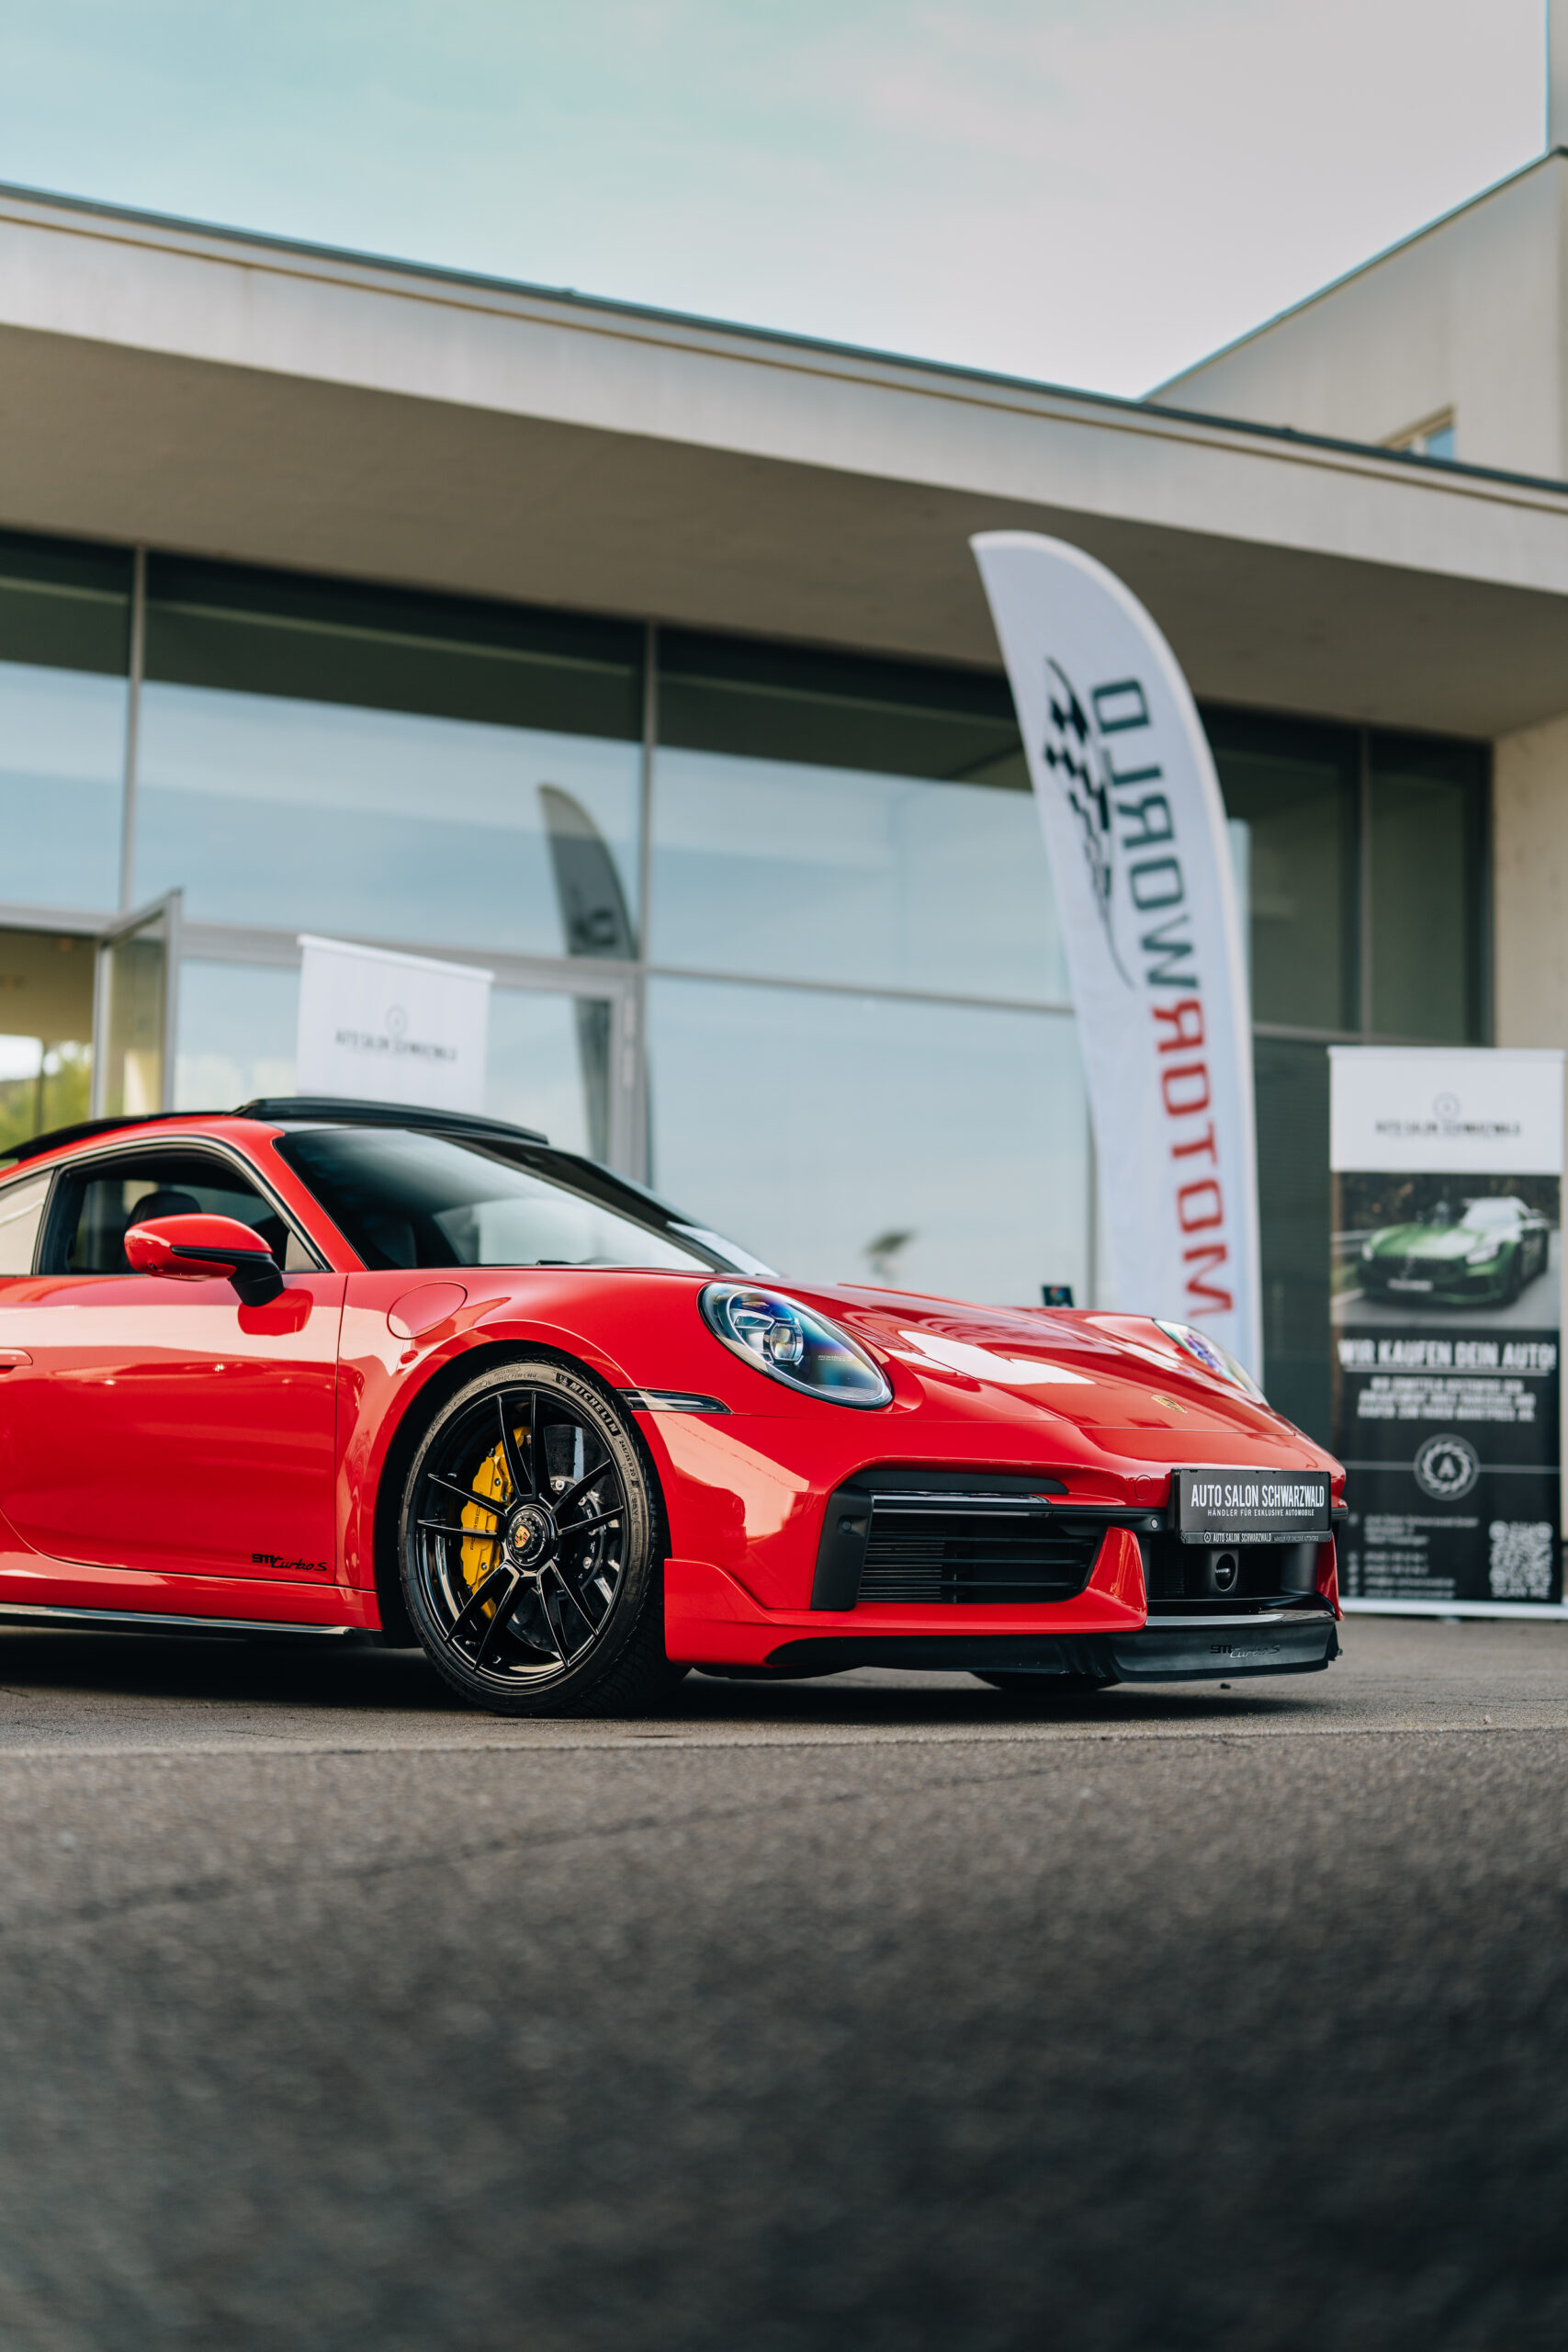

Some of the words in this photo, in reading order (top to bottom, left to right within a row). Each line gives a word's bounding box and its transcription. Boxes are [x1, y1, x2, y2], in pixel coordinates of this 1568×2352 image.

[1337, 1339, 1376, 1365] WIR
[1378, 1340, 1453, 1367] KAUFEN
[1454, 1340, 1499, 1368] DEIN
[570, 1382, 618, 1432] MICHELIN
[1190, 1484, 1222, 1508] AUTO
[1224, 1484, 1259, 1508] SALON
[1261, 1484, 1325, 1508] SCHWARZWALD
[1207, 1508, 1238, 1517] HÄNDLER
[1240, 1508, 1252, 1517] FÜR
[1254, 1509, 1284, 1517] EXKLUSIVE
[1285, 1509, 1314, 1517] AUTOMOBILE
[1213, 1532, 1225, 1543] AUTO
[1225, 1532, 1240, 1543] SALON
[1241, 1532, 1272, 1543] SCHWARZWALD
[271, 1555, 314, 1570] turbo
[313, 1562, 328, 1571] S
